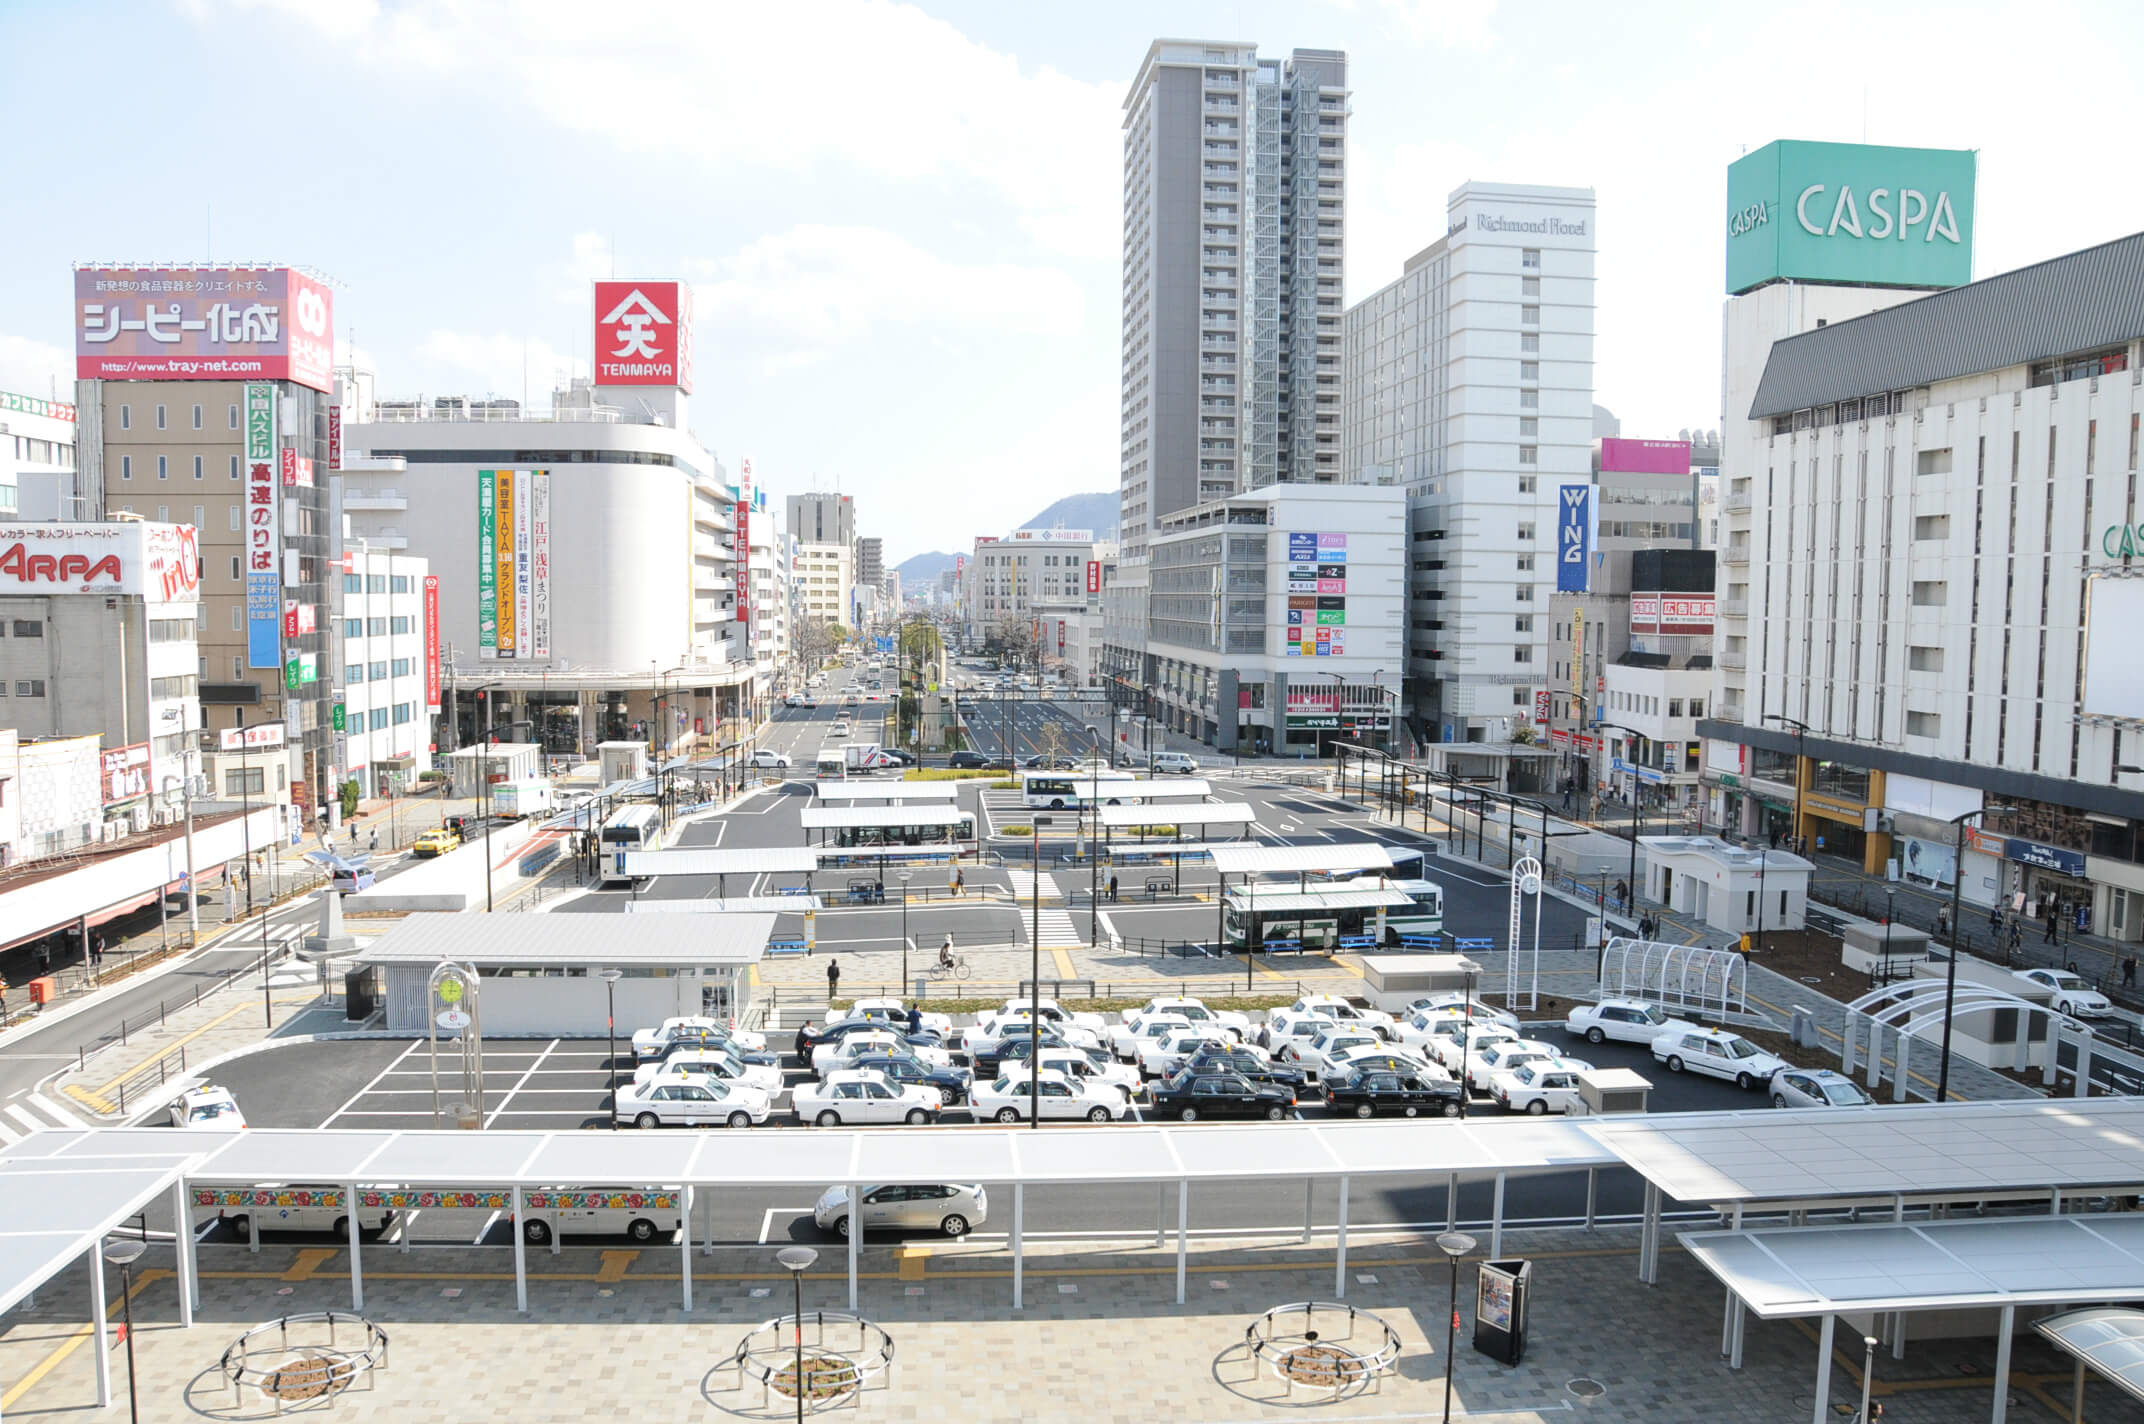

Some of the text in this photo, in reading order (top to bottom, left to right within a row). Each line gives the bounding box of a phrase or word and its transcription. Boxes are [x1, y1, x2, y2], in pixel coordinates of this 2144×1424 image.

[1476, 213, 1587, 236] Richmond Hotel
[1728, 200, 1768, 237] CASPA
[1796, 184, 1961, 243] CASPA
[83, 303, 280, 343] シーピー化成
[101, 359, 262, 373] http://www.tray-net.com
[600, 363, 673, 377] TENMAYA
[250, 463, 272, 570] 高速のりば
[1561, 489, 1588, 563] WING
[0, 542, 122, 582] ARPA
[738, 527, 746, 607] TENMAYA
